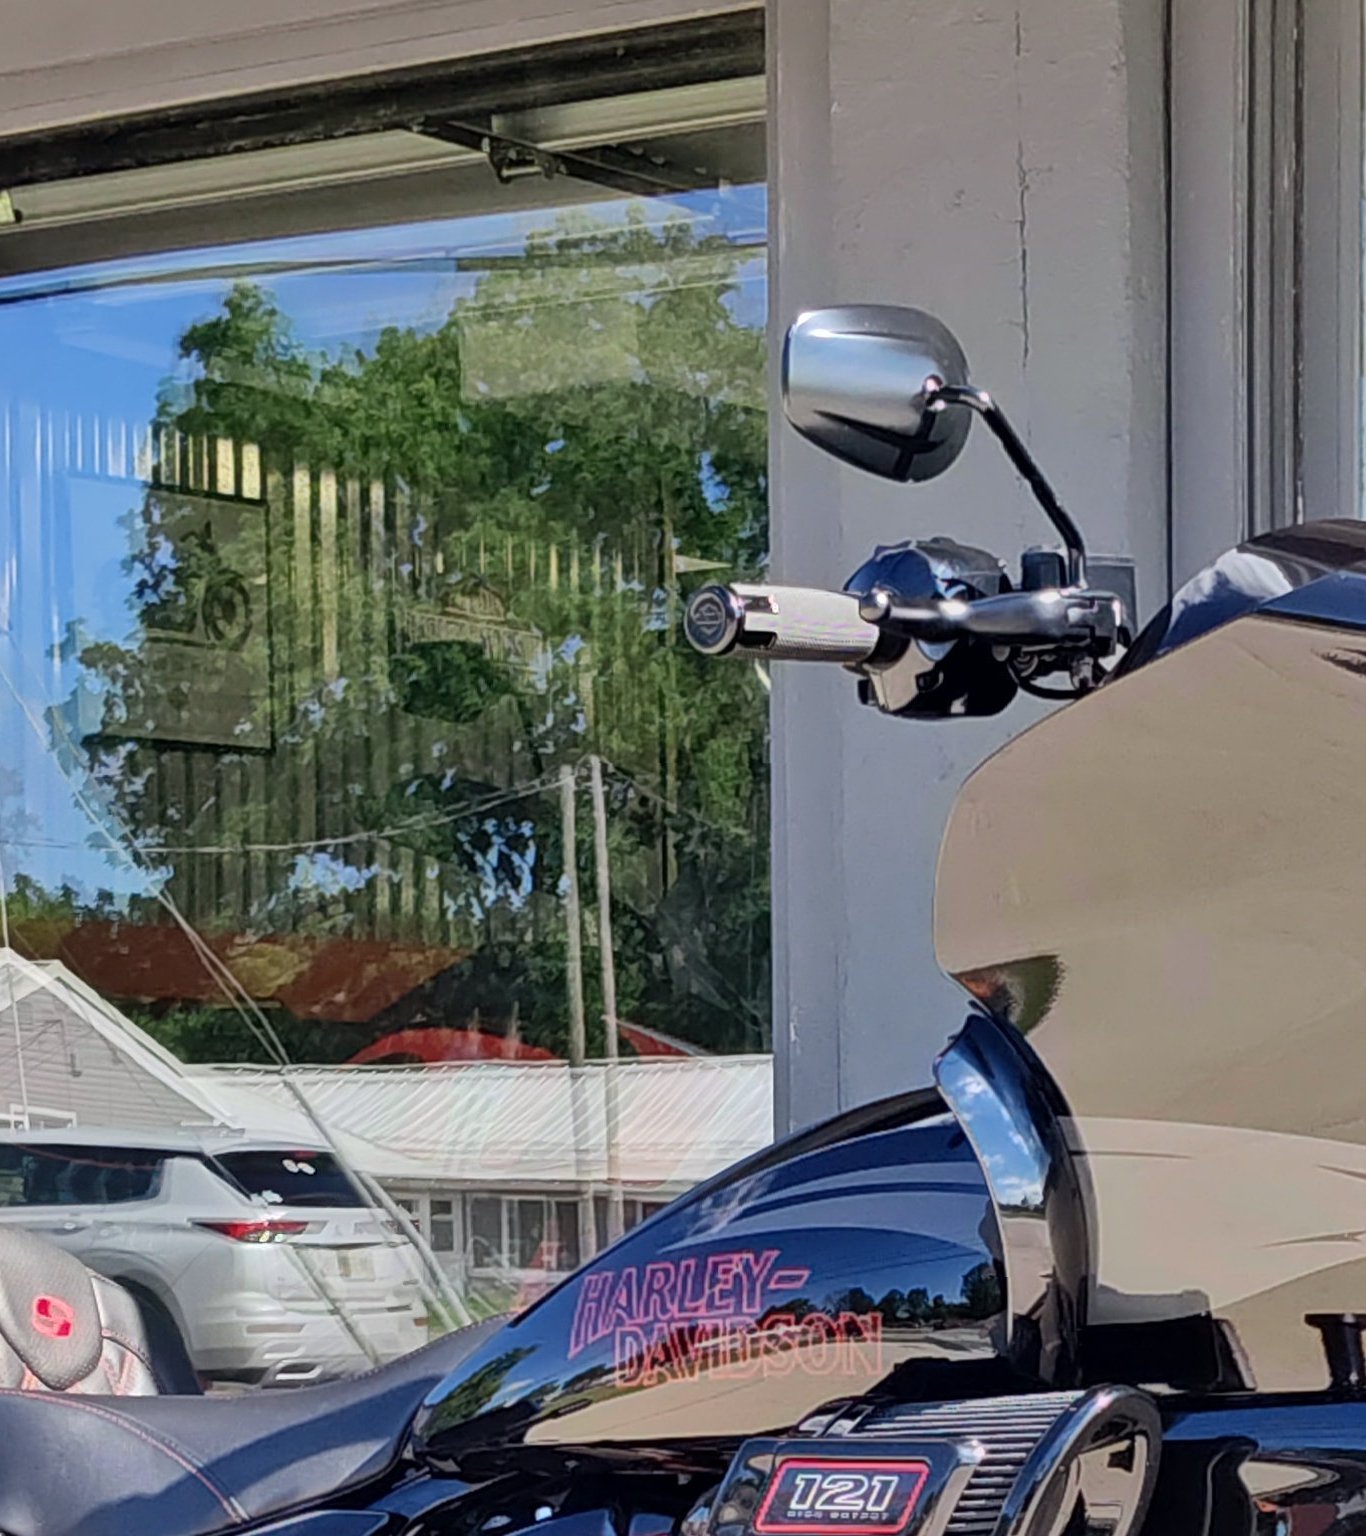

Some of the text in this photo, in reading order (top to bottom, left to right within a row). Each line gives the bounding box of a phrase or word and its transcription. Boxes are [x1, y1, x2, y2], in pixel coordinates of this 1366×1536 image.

[568, 1250, 811, 1360] HARLEY-
[614, 1311, 883, 1388] DAVIDSON
[789, 1473, 899, 1512] 121
